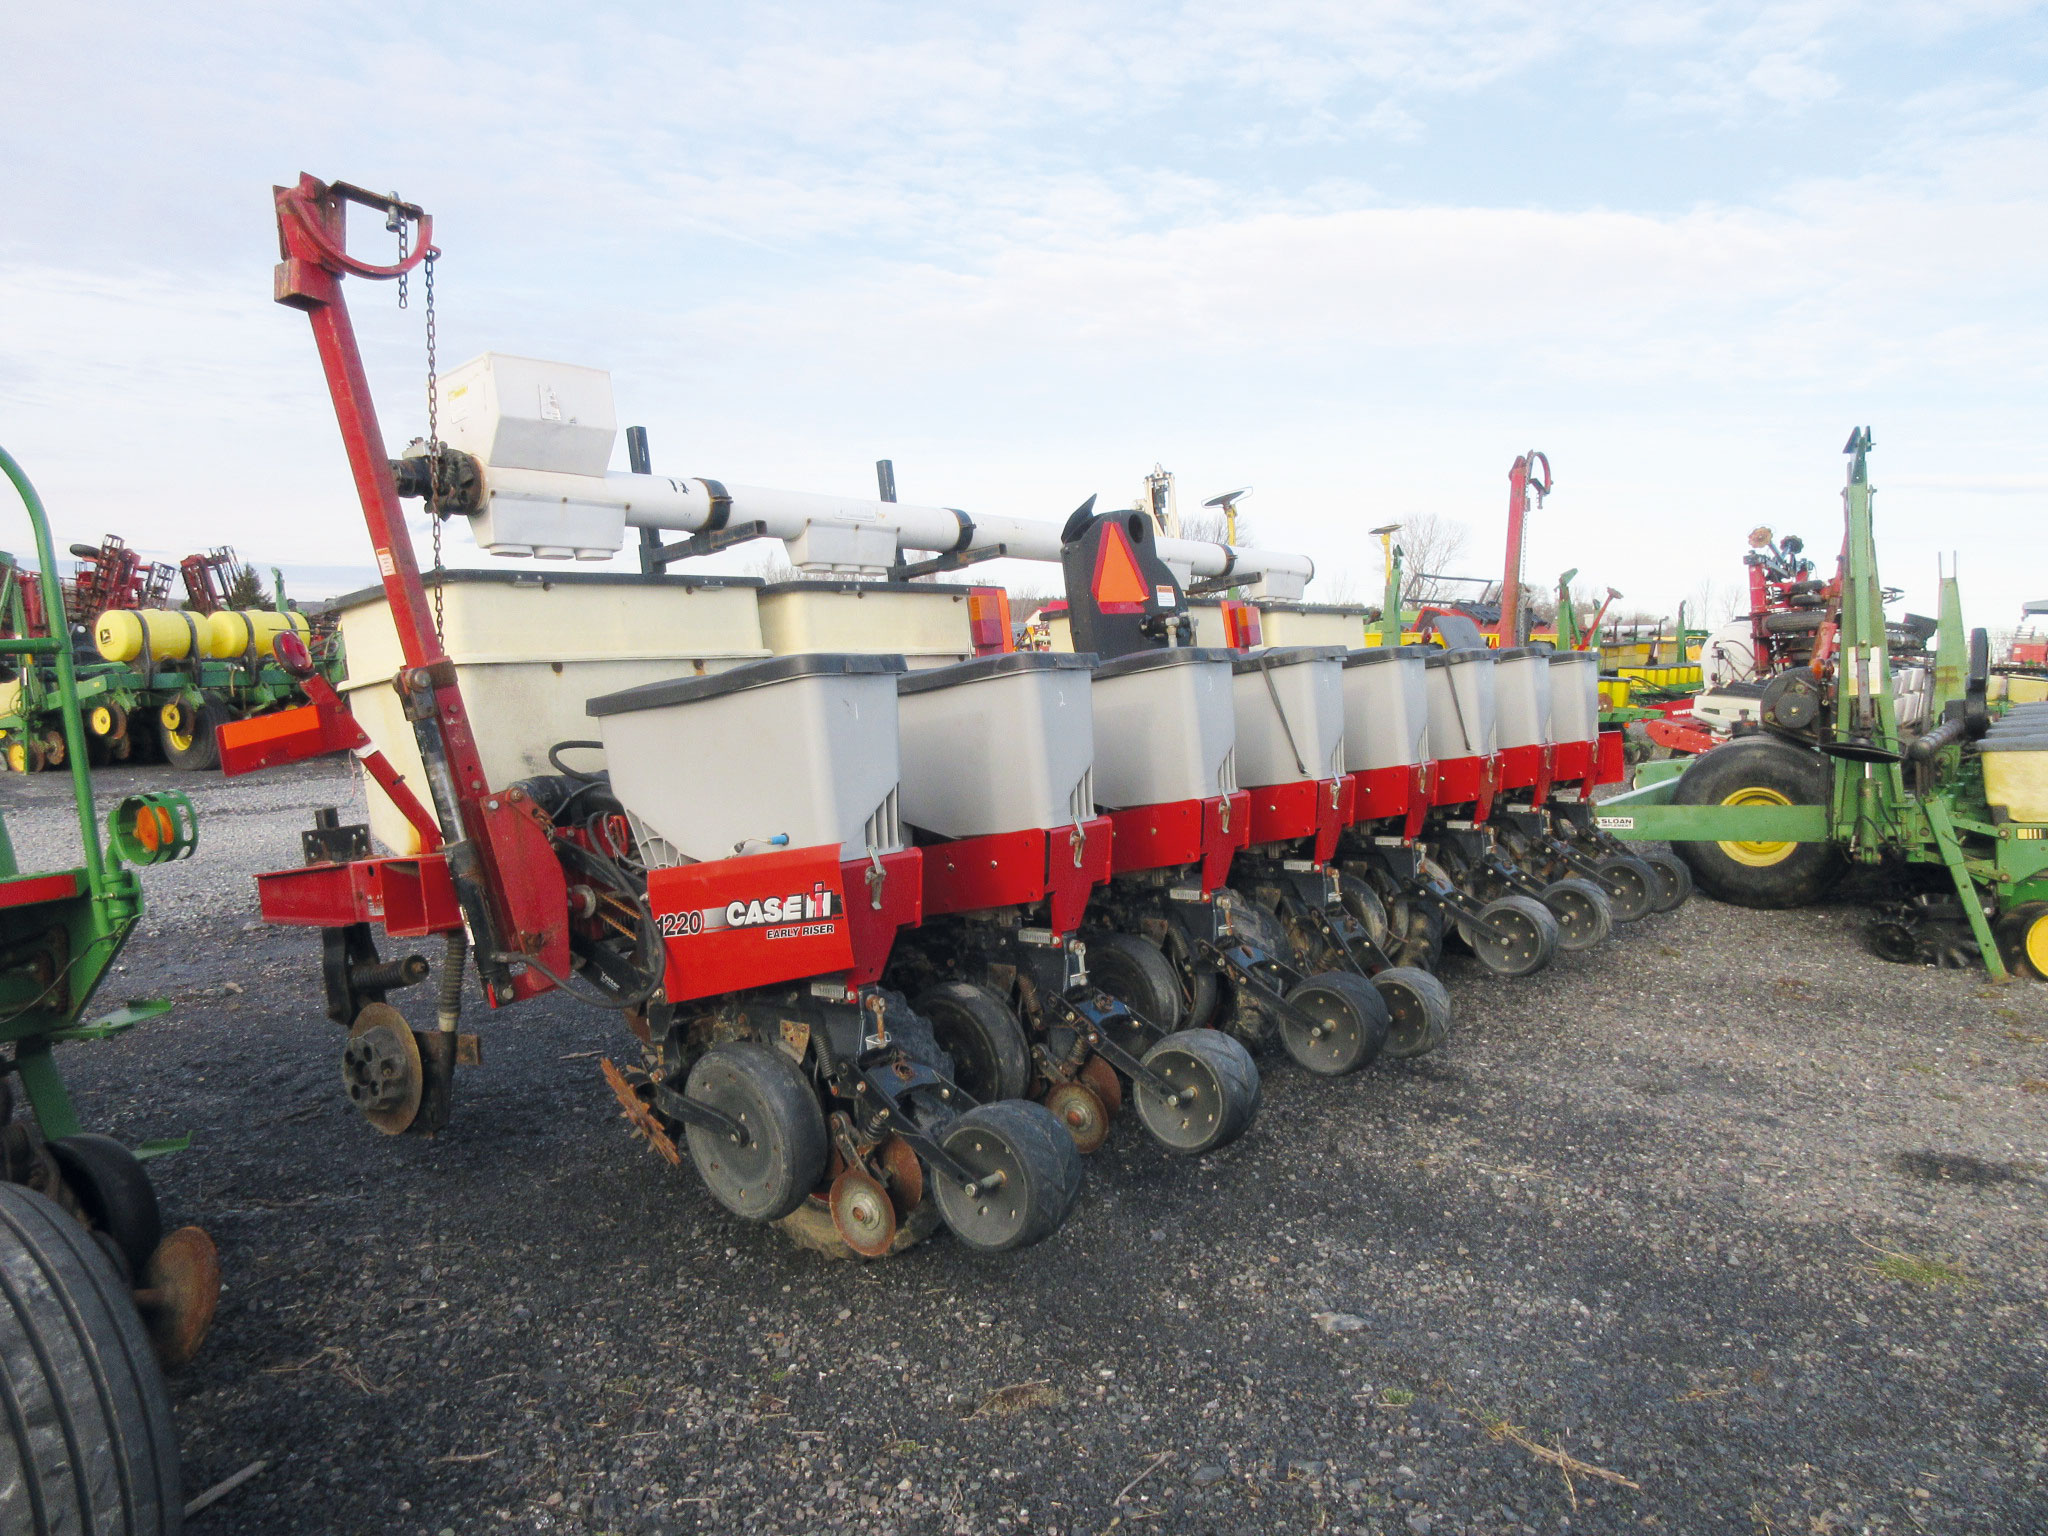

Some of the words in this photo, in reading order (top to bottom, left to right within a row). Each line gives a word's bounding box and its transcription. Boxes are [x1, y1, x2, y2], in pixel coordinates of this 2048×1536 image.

[656, 910, 703, 938] 1220
[767, 928, 801, 940] EARLY
[802, 923, 835, 937] RISER
